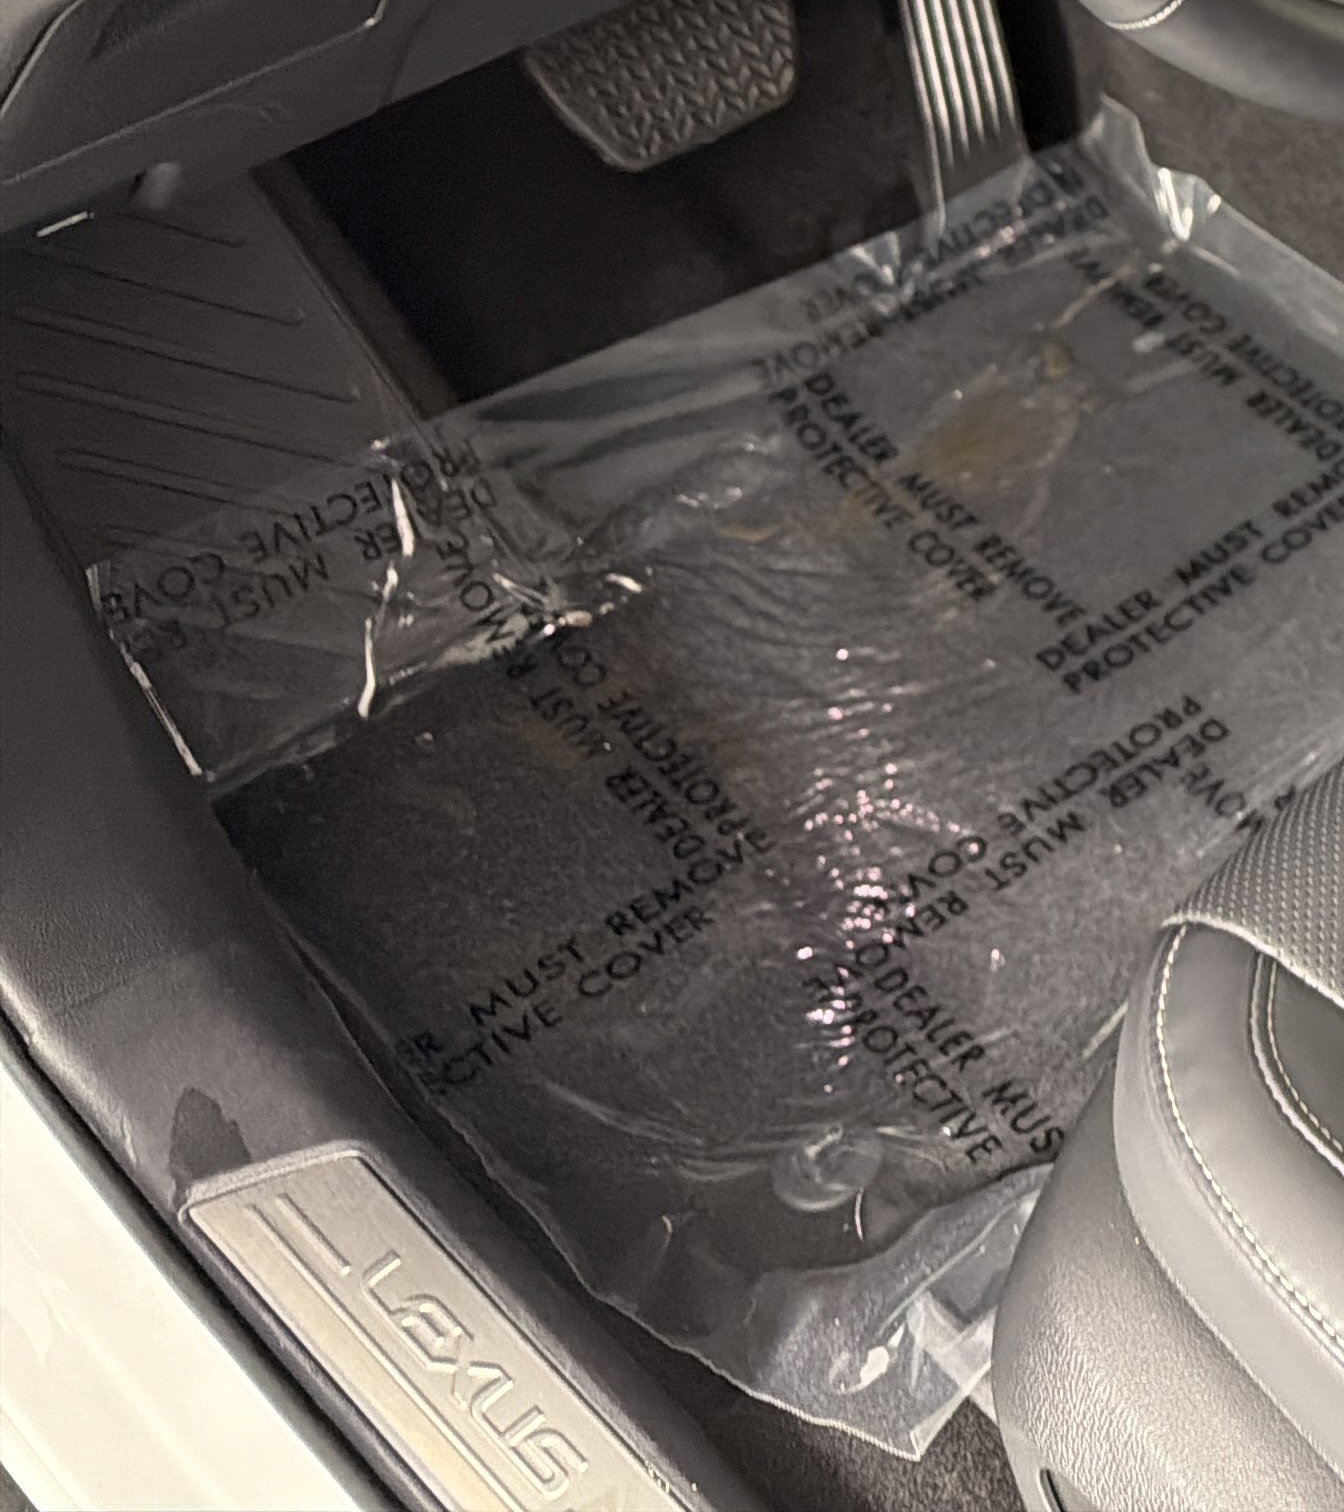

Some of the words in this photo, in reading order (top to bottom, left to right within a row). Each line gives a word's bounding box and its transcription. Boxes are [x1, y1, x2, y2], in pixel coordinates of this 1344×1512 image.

[768, 387, 914, 531] PROTECTIVE
[908, 529, 1000, 603] COVER
[805, 371, 899, 465] DEALER
[899, 472, 980, 532] MUST
[972, 533, 1087, 627] REMOVE
[213, 553, 328, 628] MUST
[1035, 589, 1162, 673] DEALER
[1174, 517, 1263, 586] MUST
[1062, 561, 1258, 694] PROTECTIVE
[597, 690, 752, 837] PROTECTIVE
[604, 764, 705, 861] DEALER
[997, 694, 1202, 838] PROTECTIVE
[1108, 718, 1230, 809] DEALER
[981, 810, 1087, 891] MUST
[467, 937, 584, 1027] MUST
[605, 828, 775, 937] REMOVE
[577, 905, 714, 998] COVER
[873, 968, 985, 1073] DEALER
[981, 1079, 1065, 1157] MUS
[360, 1250, 589, 1502] LEXUS
